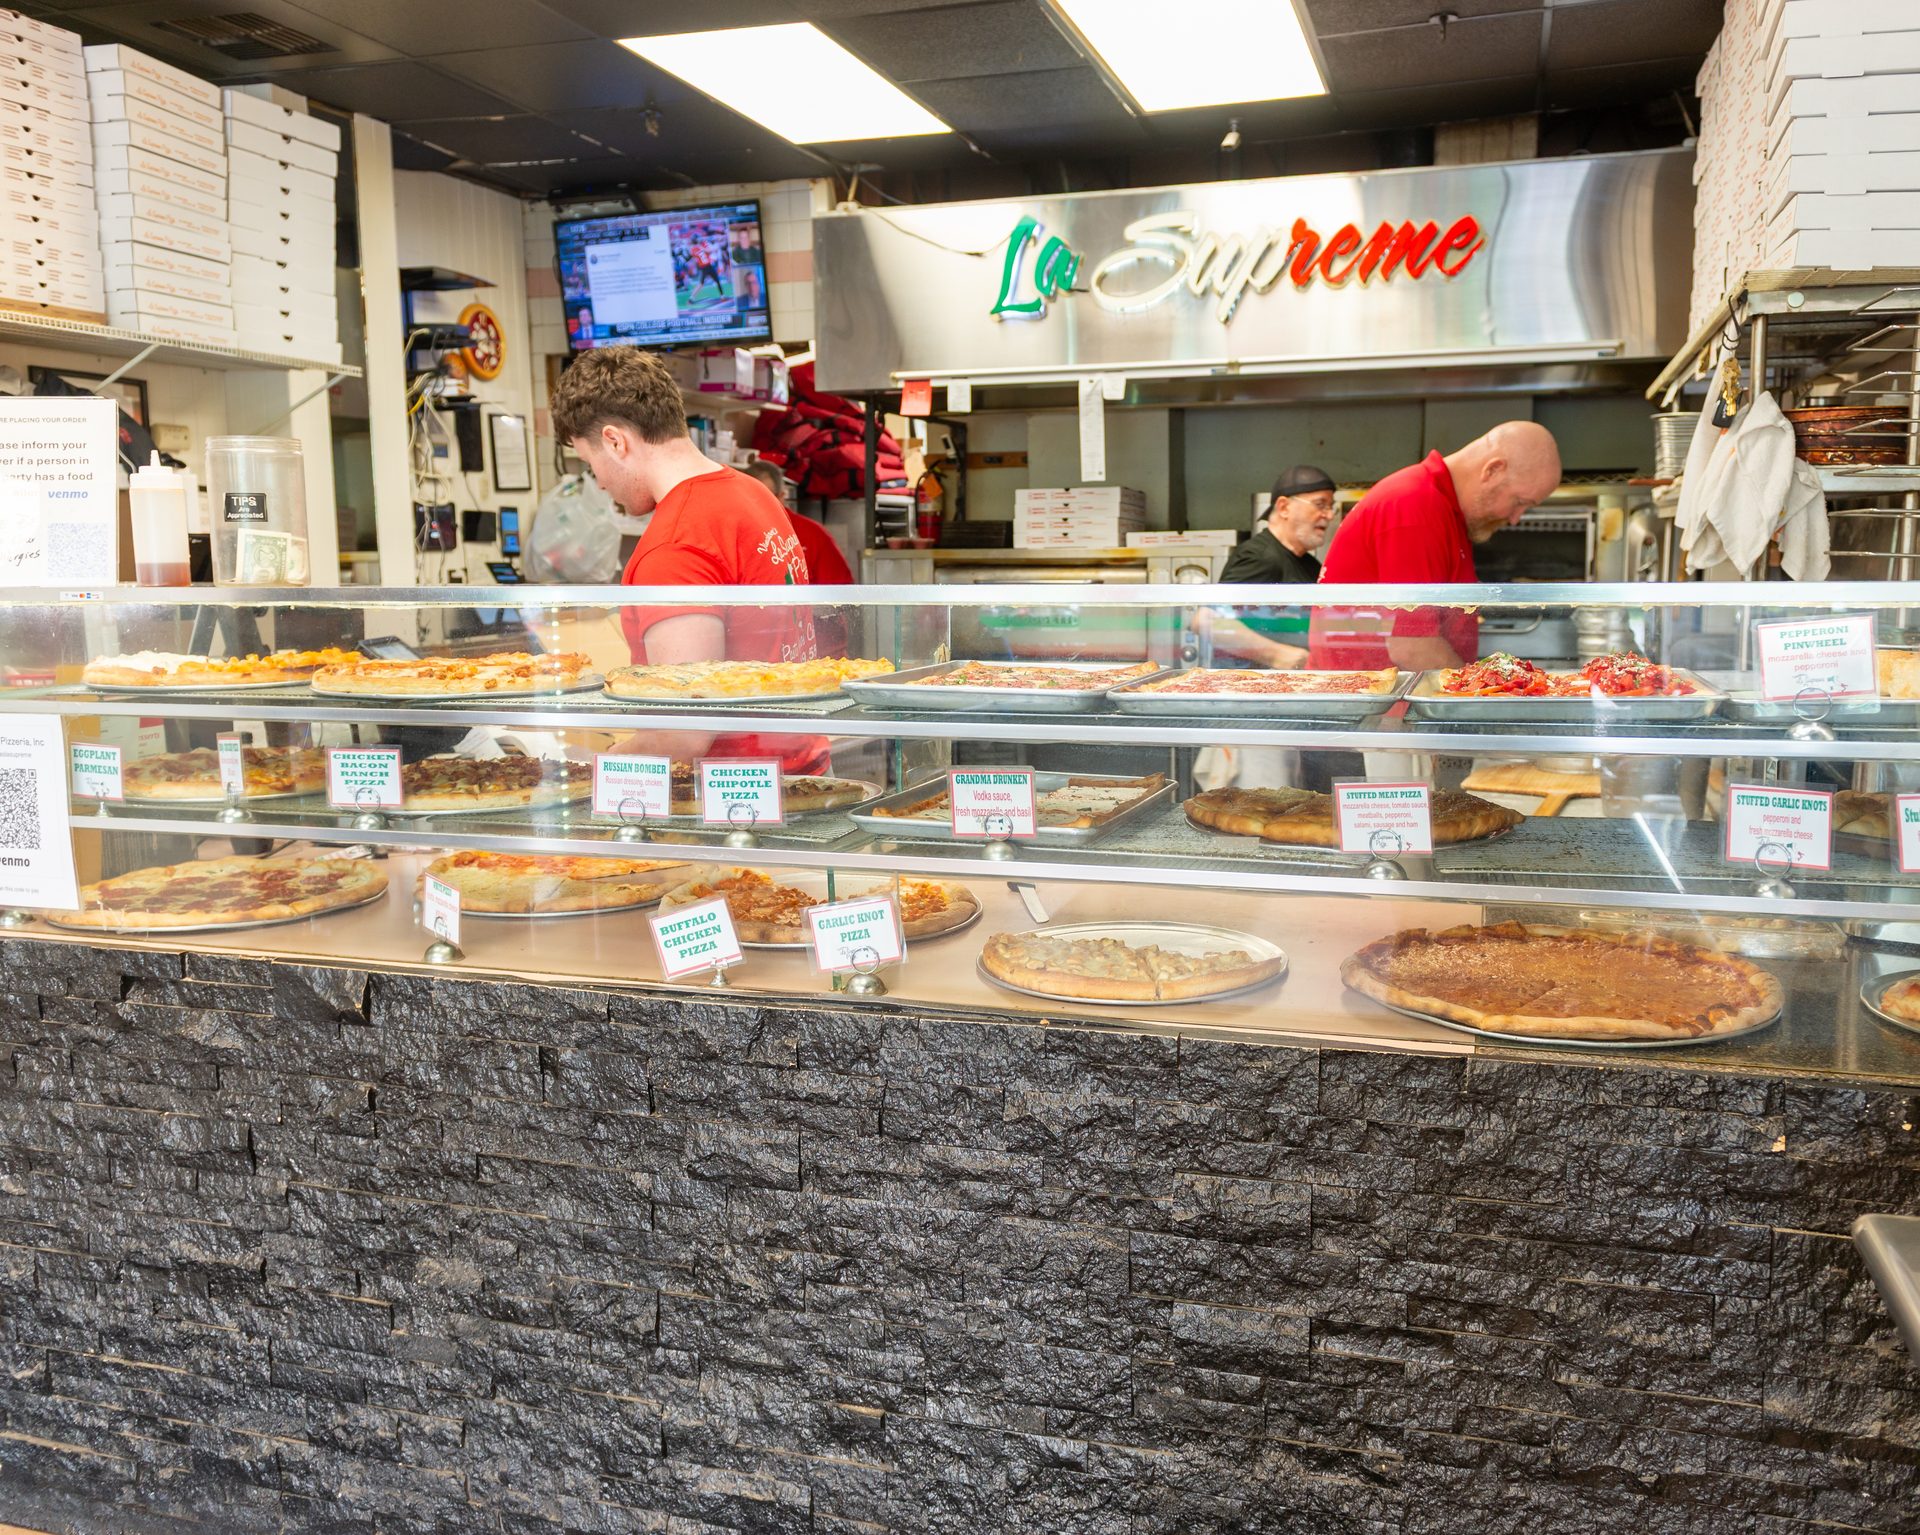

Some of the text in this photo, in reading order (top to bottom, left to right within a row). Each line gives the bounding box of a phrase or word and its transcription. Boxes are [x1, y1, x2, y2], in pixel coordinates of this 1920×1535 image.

[990, 210, 1486, 326] La Supreme
[22, 441, 59, 449] inform
[62, 442, 87, 451] your
[17, 457, 24, 465] if
[37, 458, 76, 467] person
[35, 473, 56, 481] has
[68, 473, 93, 481] food
[48, 491, 89, 499] venmo
[231, 496, 257, 506] TIPS
[1780, 626, 1849, 639] PEPPERONI
[1783, 637, 1847, 650] PINWHEEL
[1768, 648, 1867, 663] mozzarella cheese and
[1794, 661, 1839, 671] pepperoni
[73, 749, 117, 760] EGGPLANT
[74, 763, 119, 775] PARMESAN
[603, 762, 666, 775] RUSSIAN BOMBER
[711, 769, 768, 777] CHICKEN
[605, 776, 623, 785] Russian
[708, 780, 772, 788] CHIPOTLE
[955, 774, 1028, 785] GRANDMA DRUNKEN
[622, 789, 647, 798] bacon with
[973, 790, 1013, 802] Vodka sauce,
[1346, 790, 1422, 800] STUFFED MEAT PIZZA
[645, 802, 661, 810] cheese
[1736, 794, 1828, 812] STUFFED GARLIC KNOTS
[955, 806, 971, 817] fresh
[1004, 807, 1016, 817] and
[1016, 807, 1031, 818] basil
[1384, 812, 1413, 820] pepperoni,
[1762, 814, 1802, 825] pepperoni and
[1373, 822, 1395, 830] sausage
[1748, 825, 1814, 840] fresh mozzarella cheese
[0, 857, 30, 867] enmo
[659, 912, 717, 936] BUFFALO
[818, 909, 885, 930] GARLIC KNOT
[663, 924, 722, 949] CHICKEN
[840, 928, 871, 943] PIZZA
[678, 940, 718, 959] PIZZA
